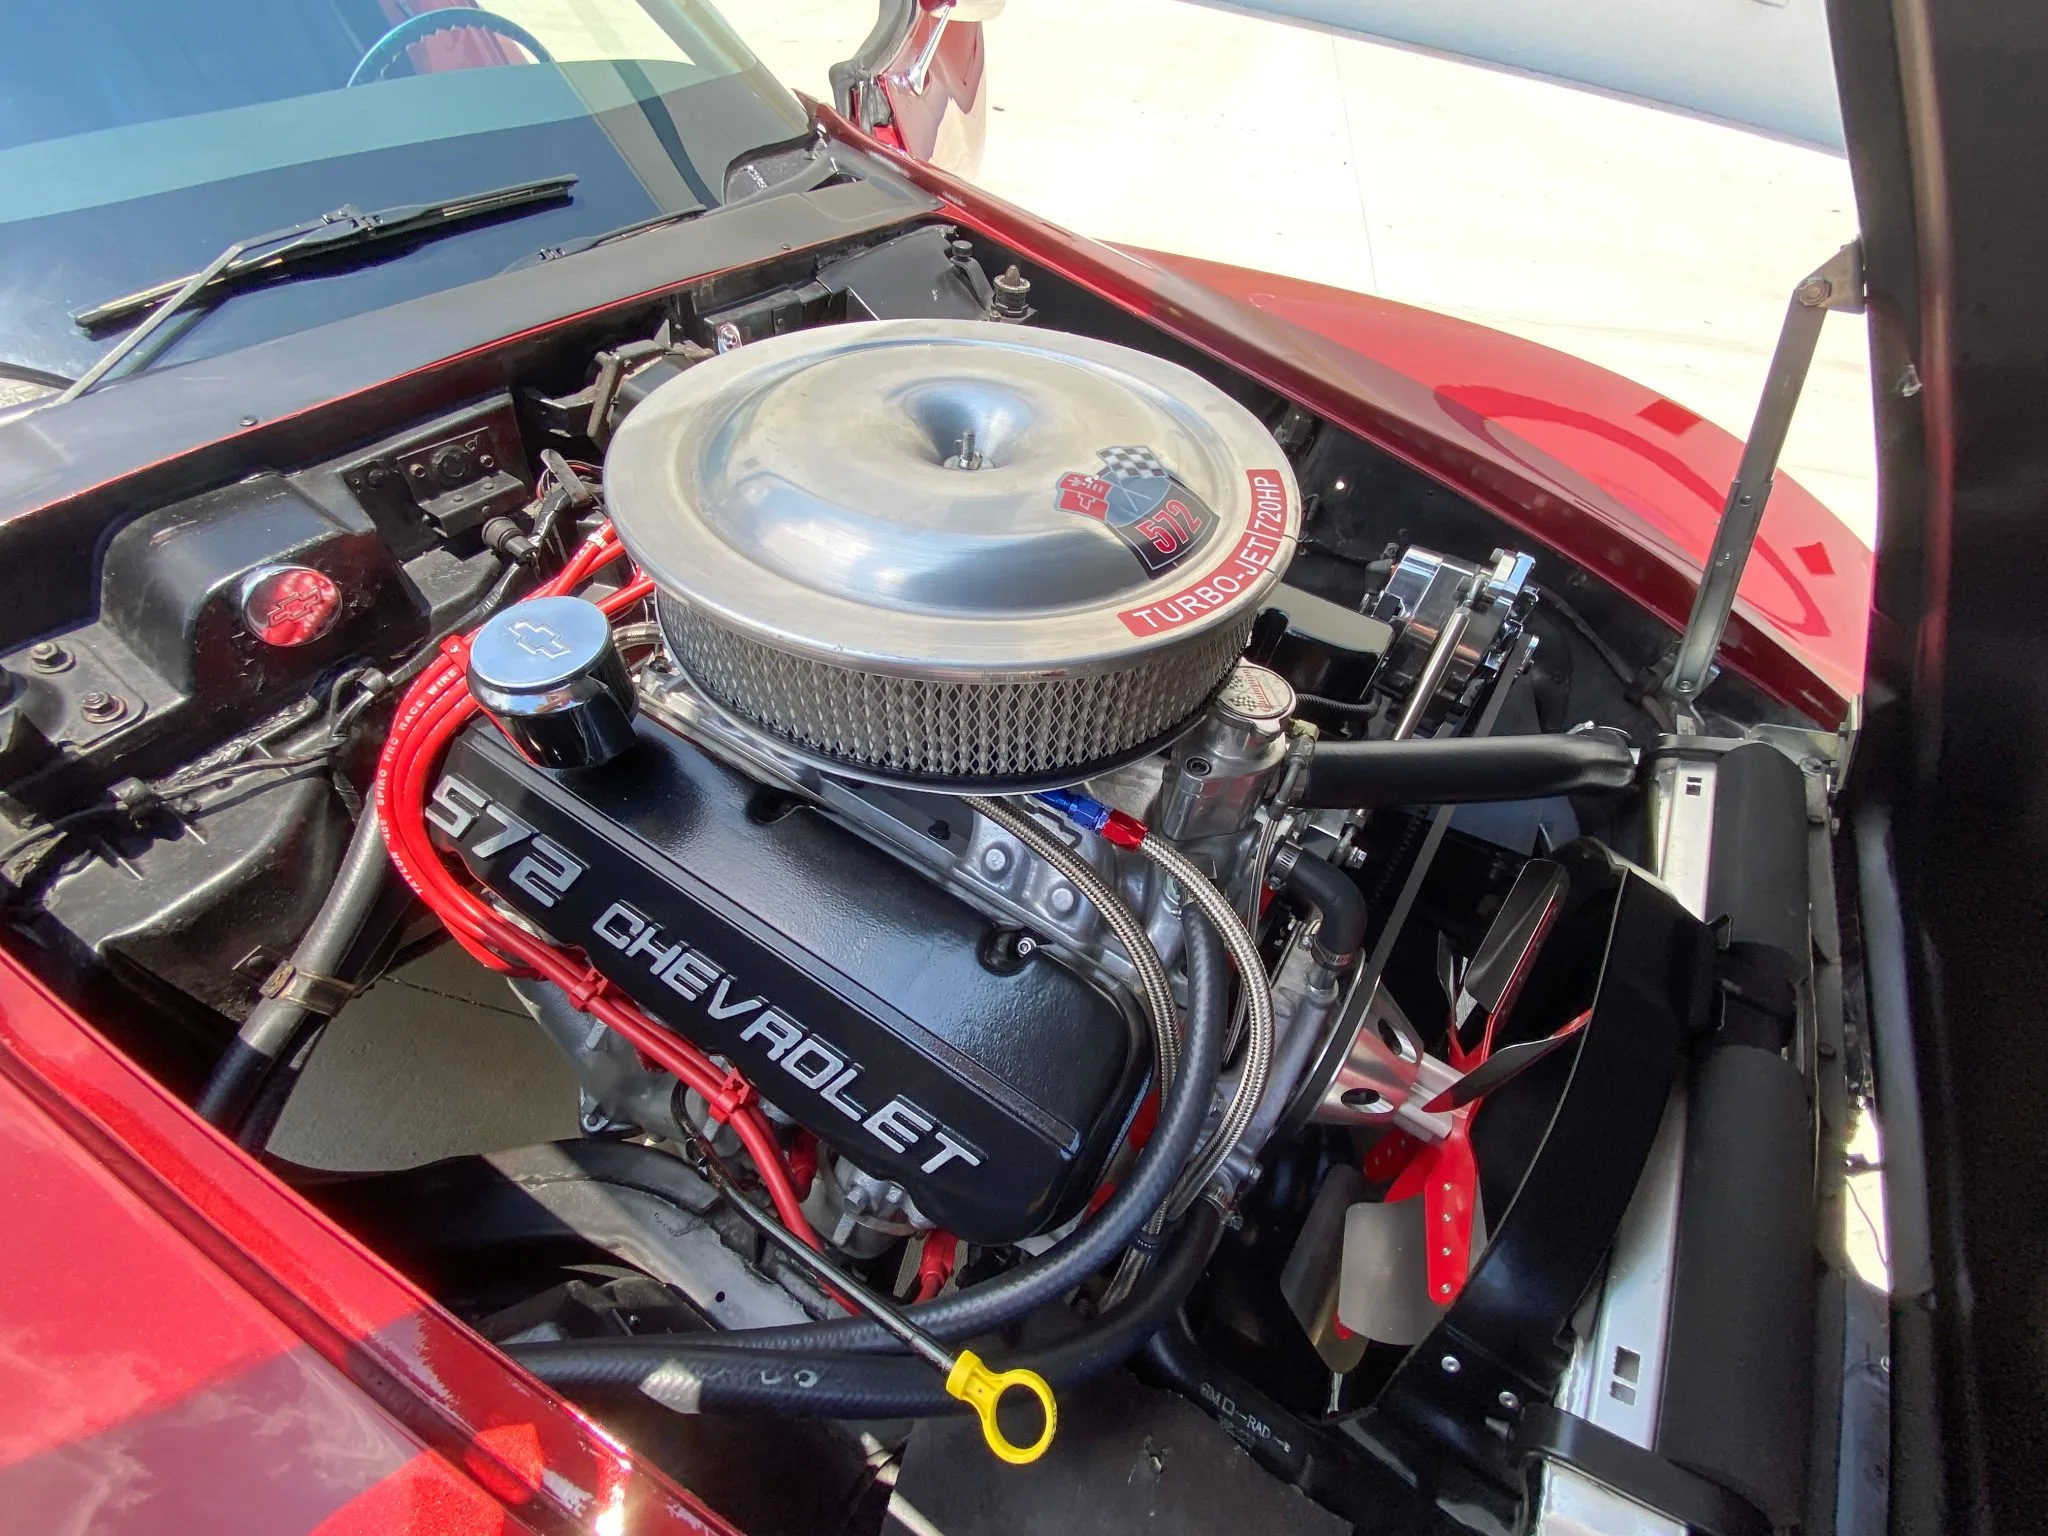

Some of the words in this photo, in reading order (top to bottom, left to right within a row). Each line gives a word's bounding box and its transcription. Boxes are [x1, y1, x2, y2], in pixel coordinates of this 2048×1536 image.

[1134, 499, 1201, 554] 572
[1132, 535, 1275, 628] TURBO-JET
[1253, 476, 1280, 532] 720HP
[427, 668, 457, 695] WIRE
[398, 700, 425, 731] RACE
[383, 737, 399, 762] PRO
[391, 851, 423, 894] TAYLOR
[425, 774, 588, 908] 572
[592, 900, 986, 1173] CHEVROLET
